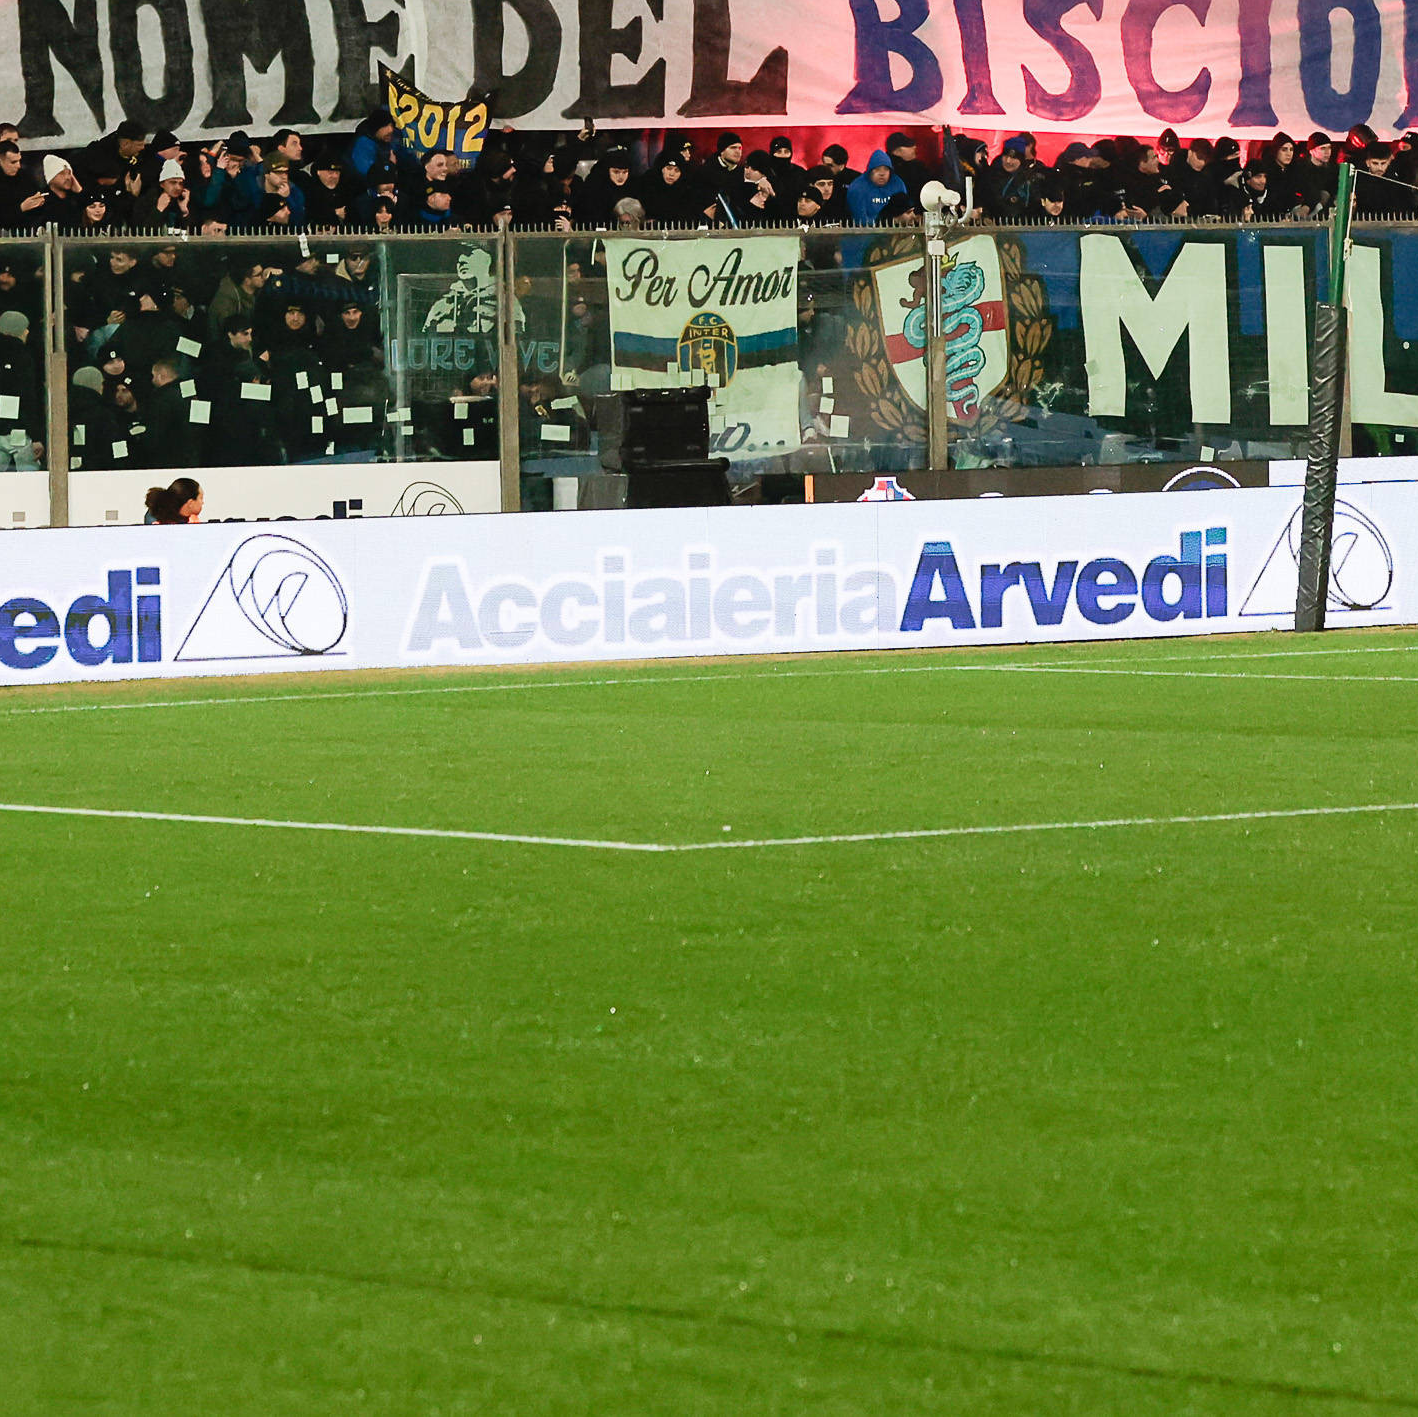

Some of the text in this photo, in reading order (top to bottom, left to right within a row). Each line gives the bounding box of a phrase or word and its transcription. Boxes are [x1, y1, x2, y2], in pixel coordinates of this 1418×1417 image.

[615, 247, 794, 309] Per Amor
[391, 338, 560, 373] LORE VVE
[689, 327, 729, 339] INTER
[408, 525, 1229, 653] Acciaieria Arvedi
